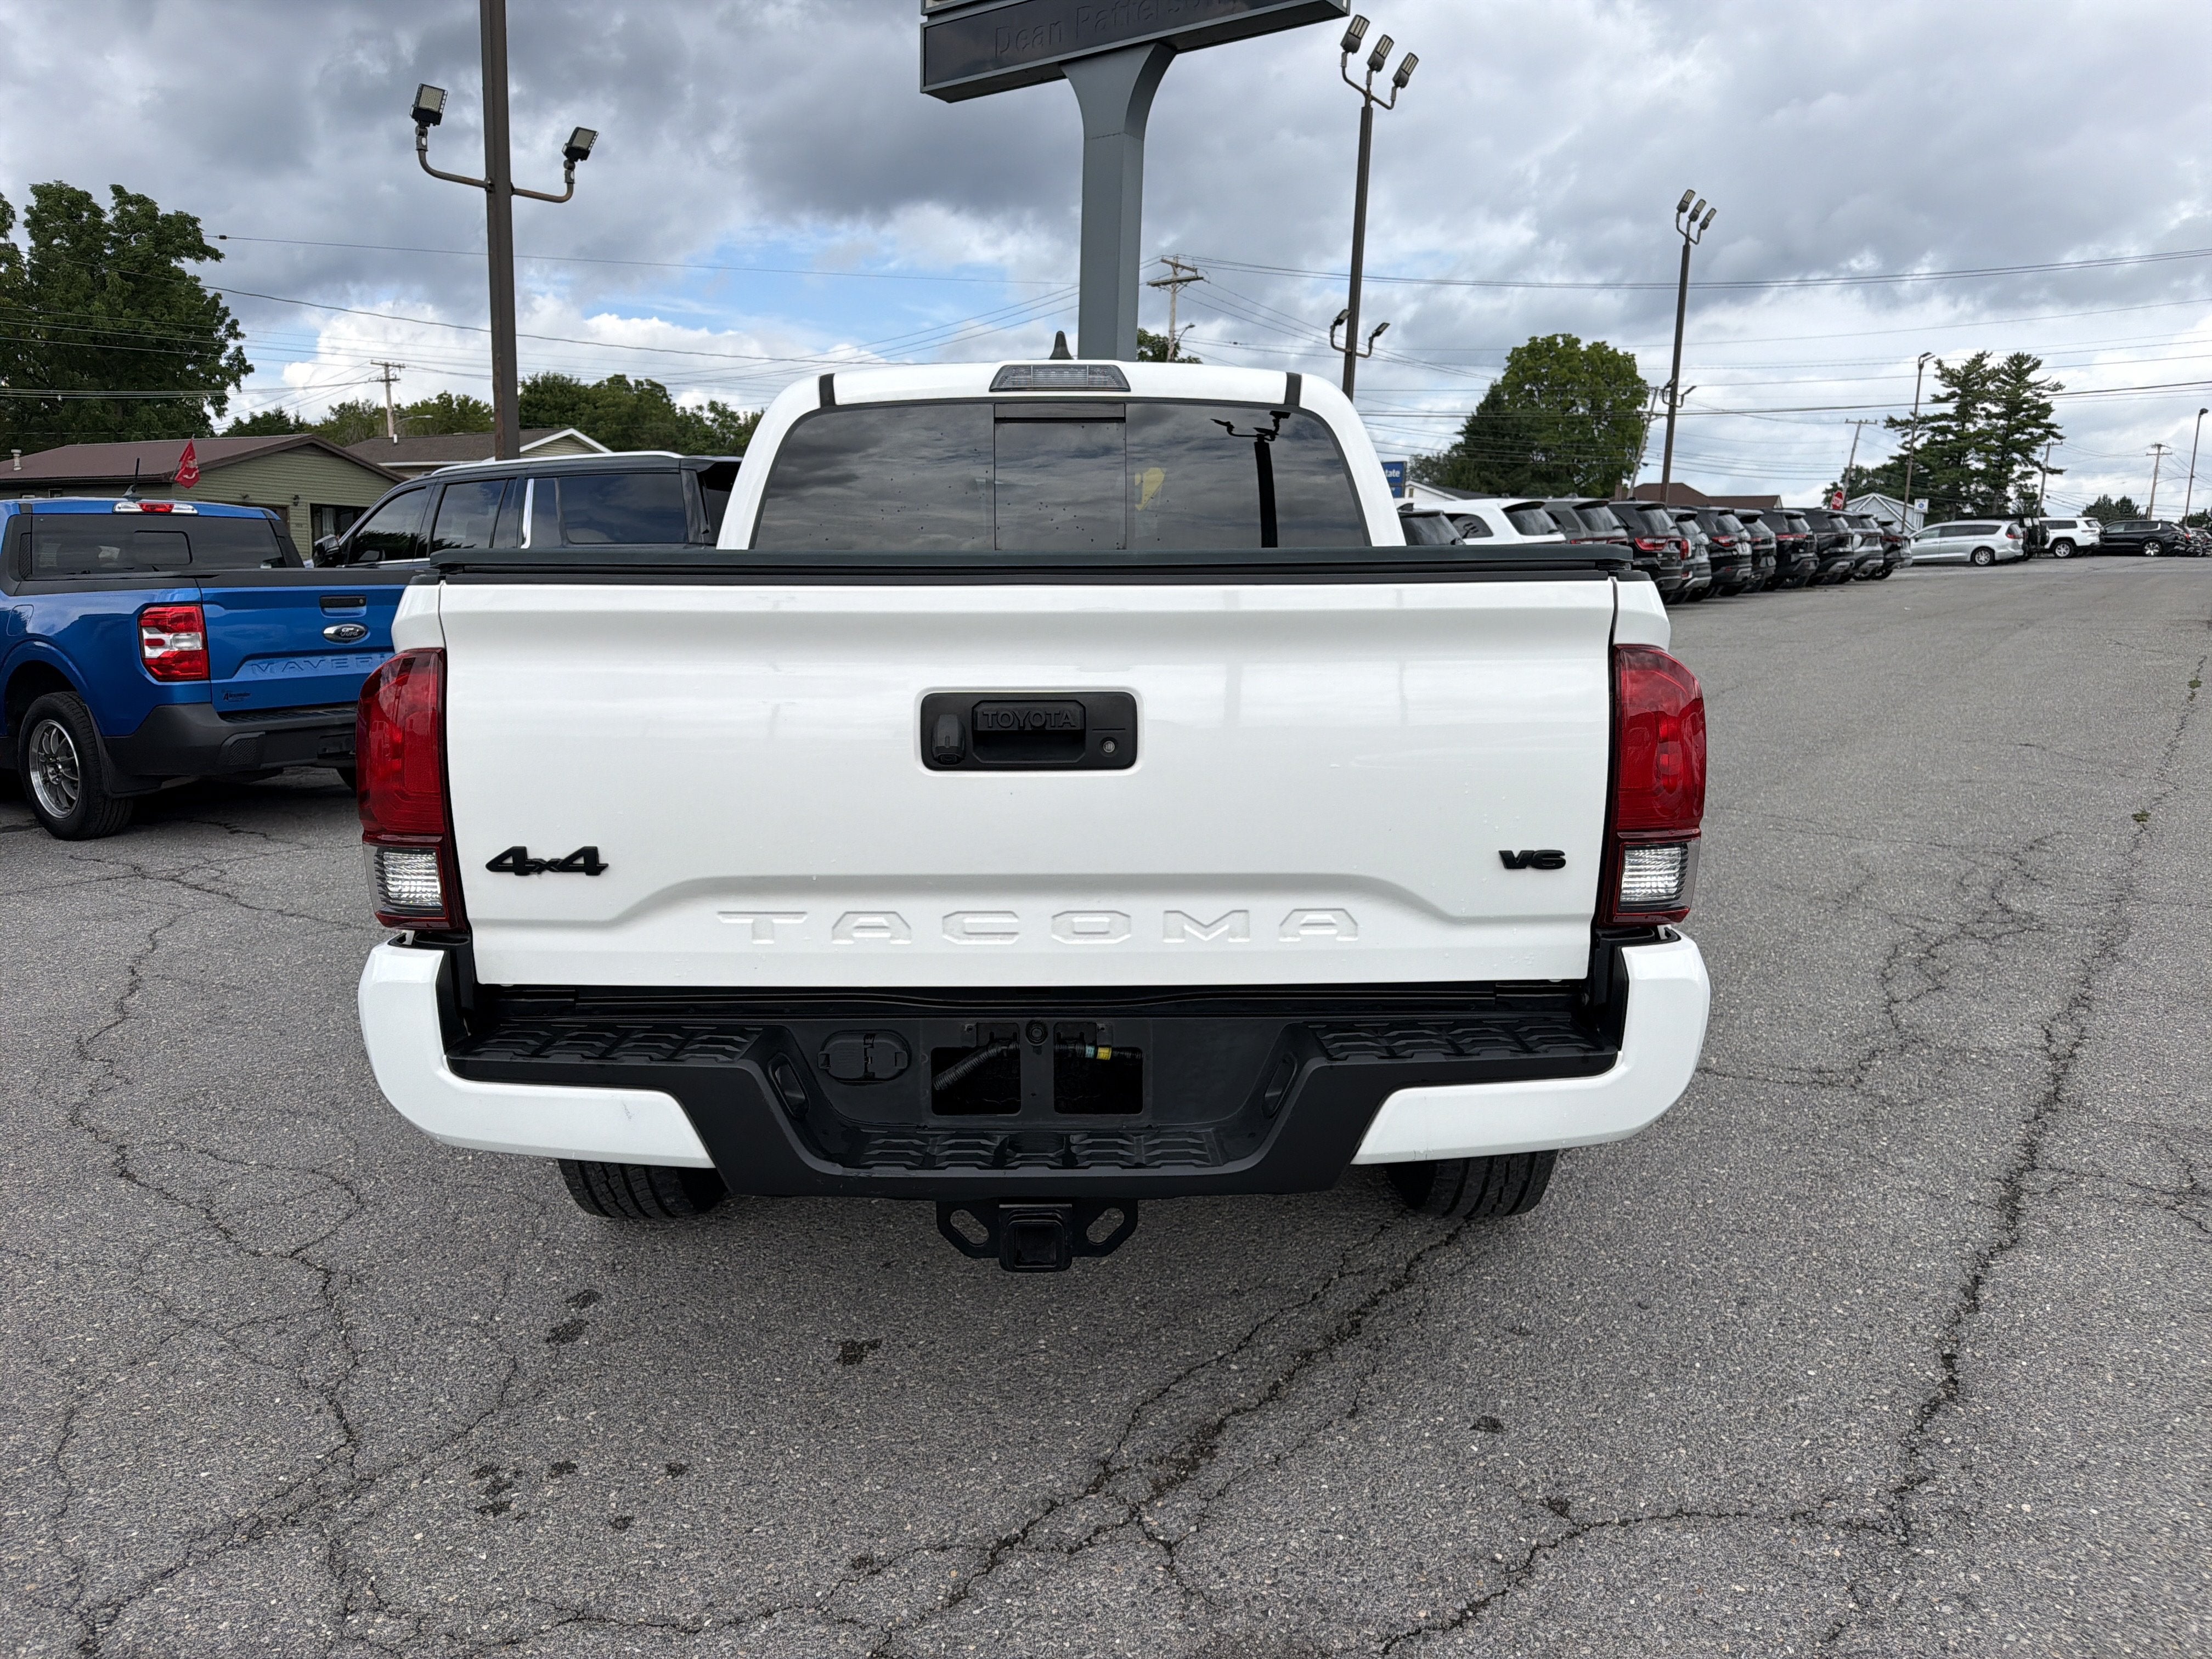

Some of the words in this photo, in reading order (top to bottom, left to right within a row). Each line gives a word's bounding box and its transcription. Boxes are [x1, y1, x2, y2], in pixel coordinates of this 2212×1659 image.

[995, 21, 1063, 59] Dean
[340, 628, 360, 637] Ford
[982, 710, 1077, 730] TOYOTA
[486, 845, 609, 876] 4x4
[1498, 849, 1566, 870] V6
[716, 908, 1359, 945] TACOMA
